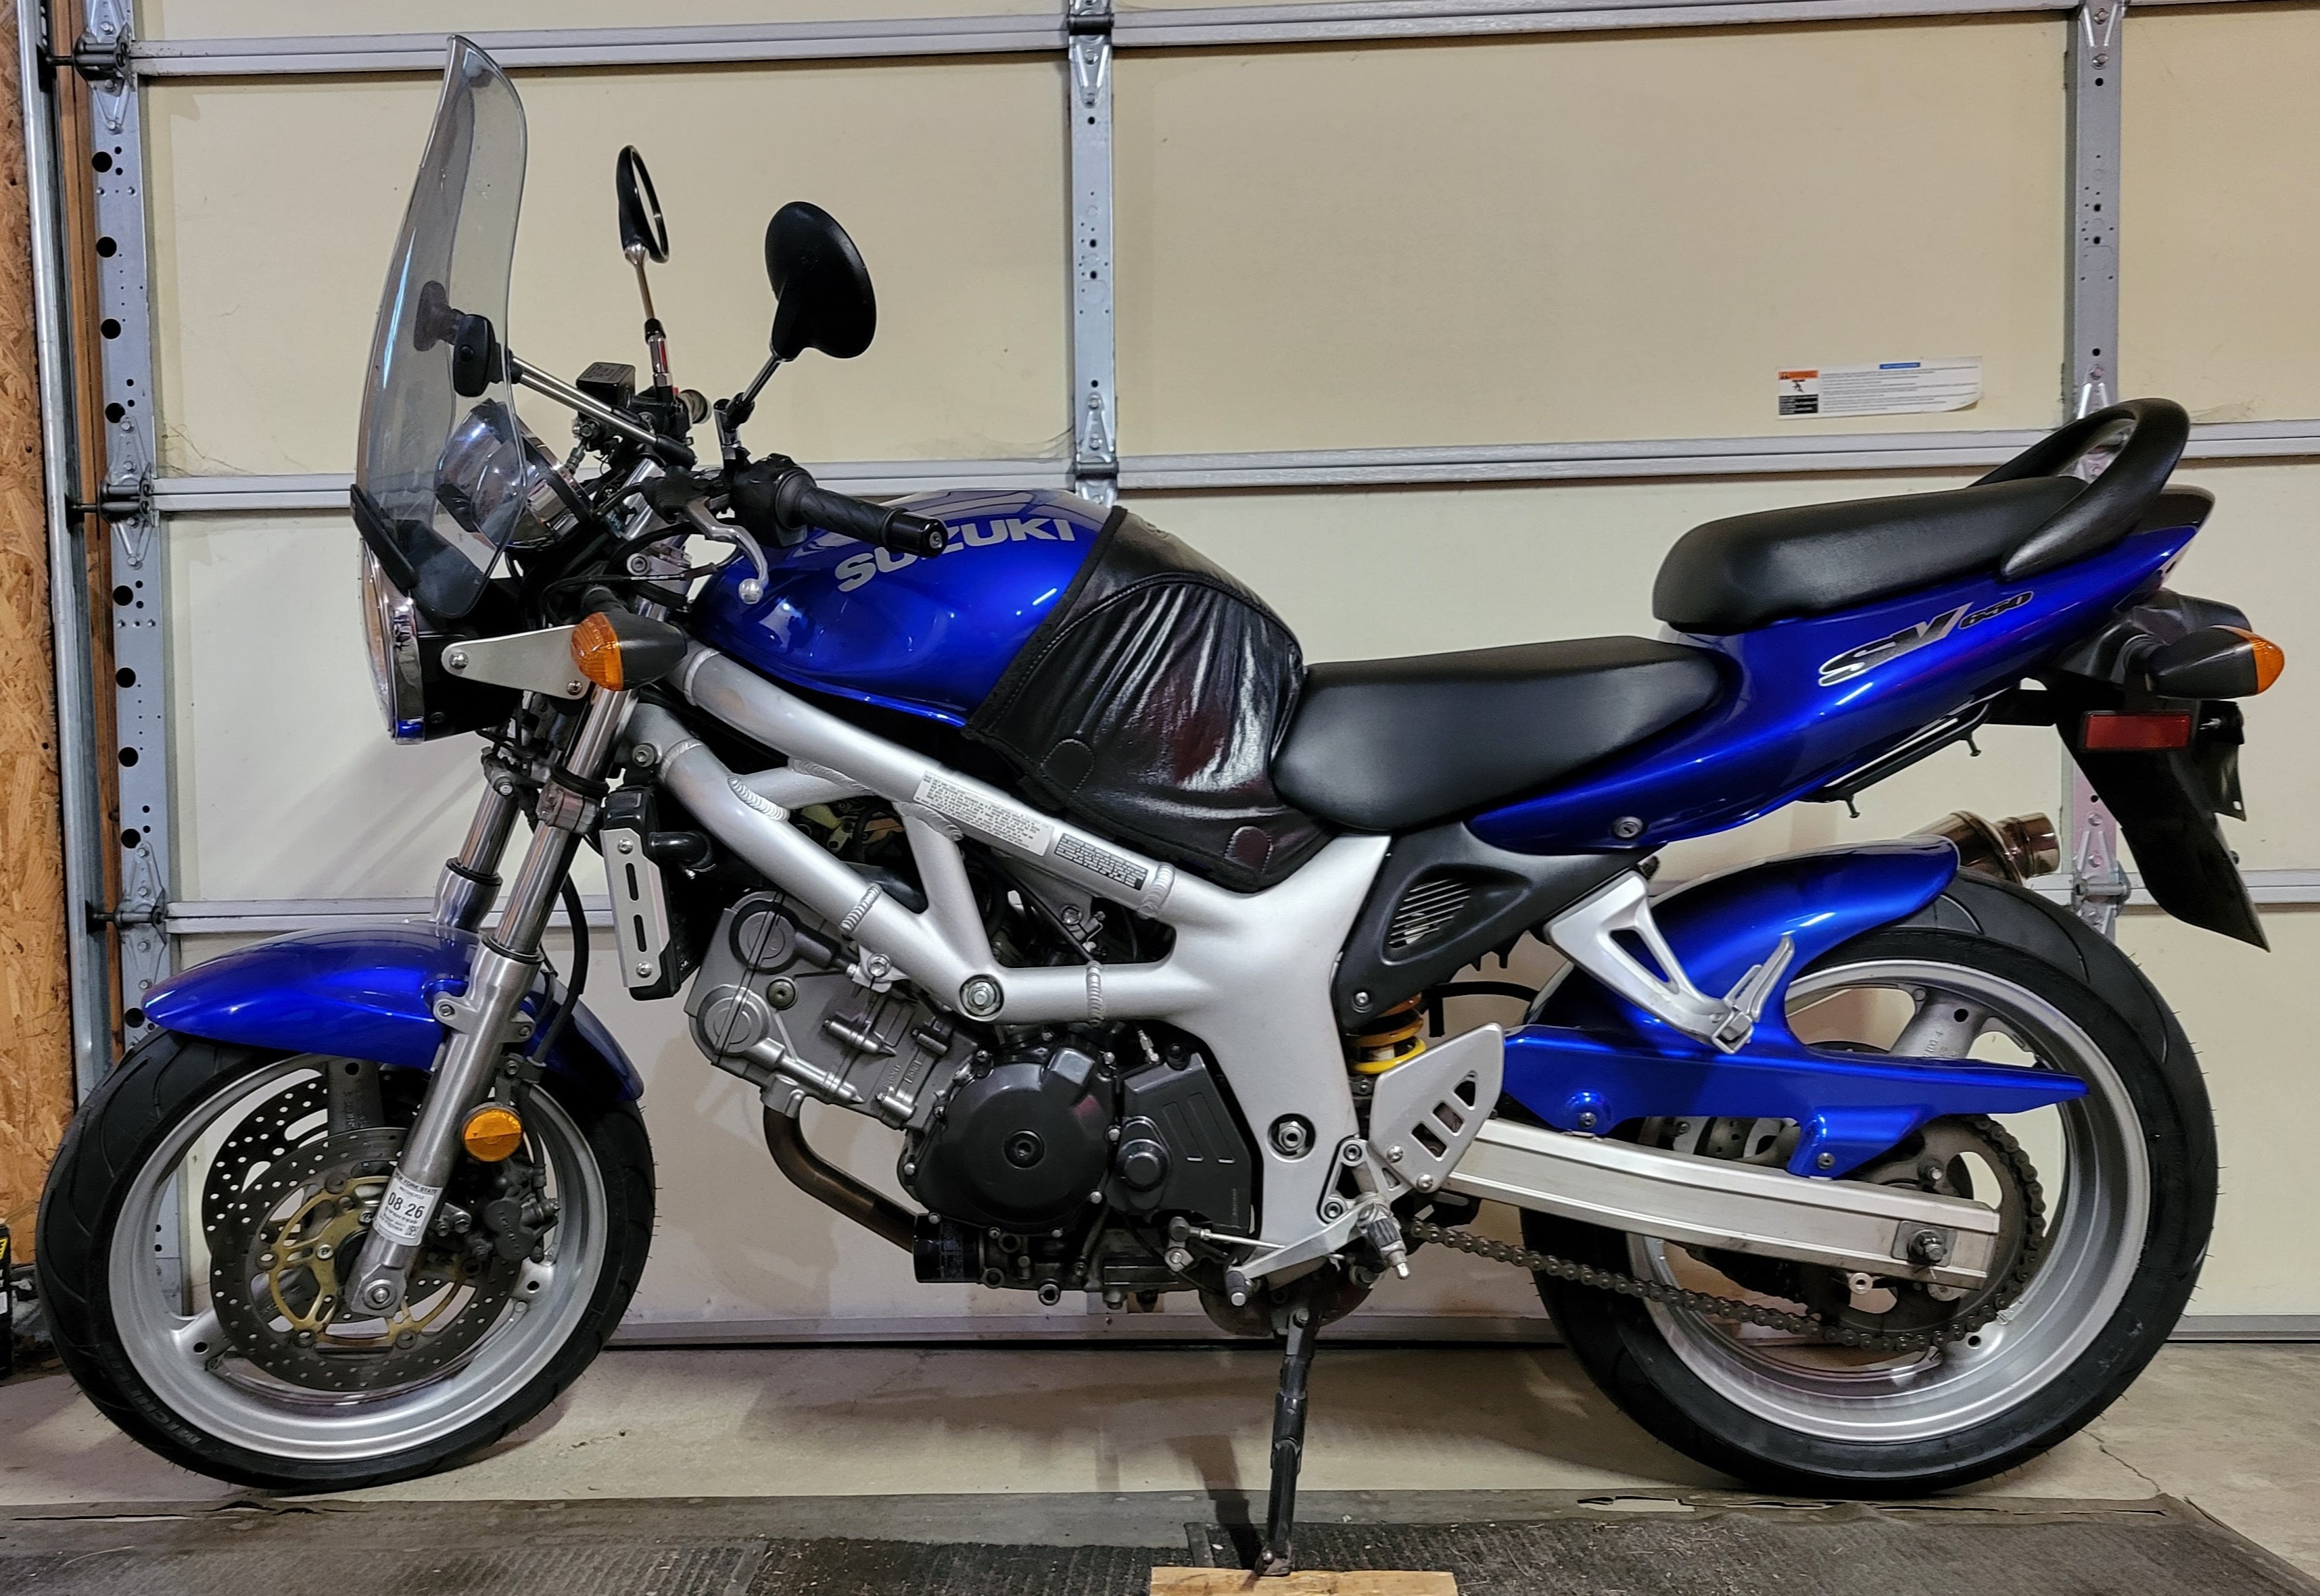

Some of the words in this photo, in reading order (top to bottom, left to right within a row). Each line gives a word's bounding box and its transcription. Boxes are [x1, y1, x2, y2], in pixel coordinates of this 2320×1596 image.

[404, 1179, 419, 1190] YORK
[419, 1186, 438, 1194] STATE
[387, 1191, 404, 1211] 08
[404, 1203, 425, 1219] 26
